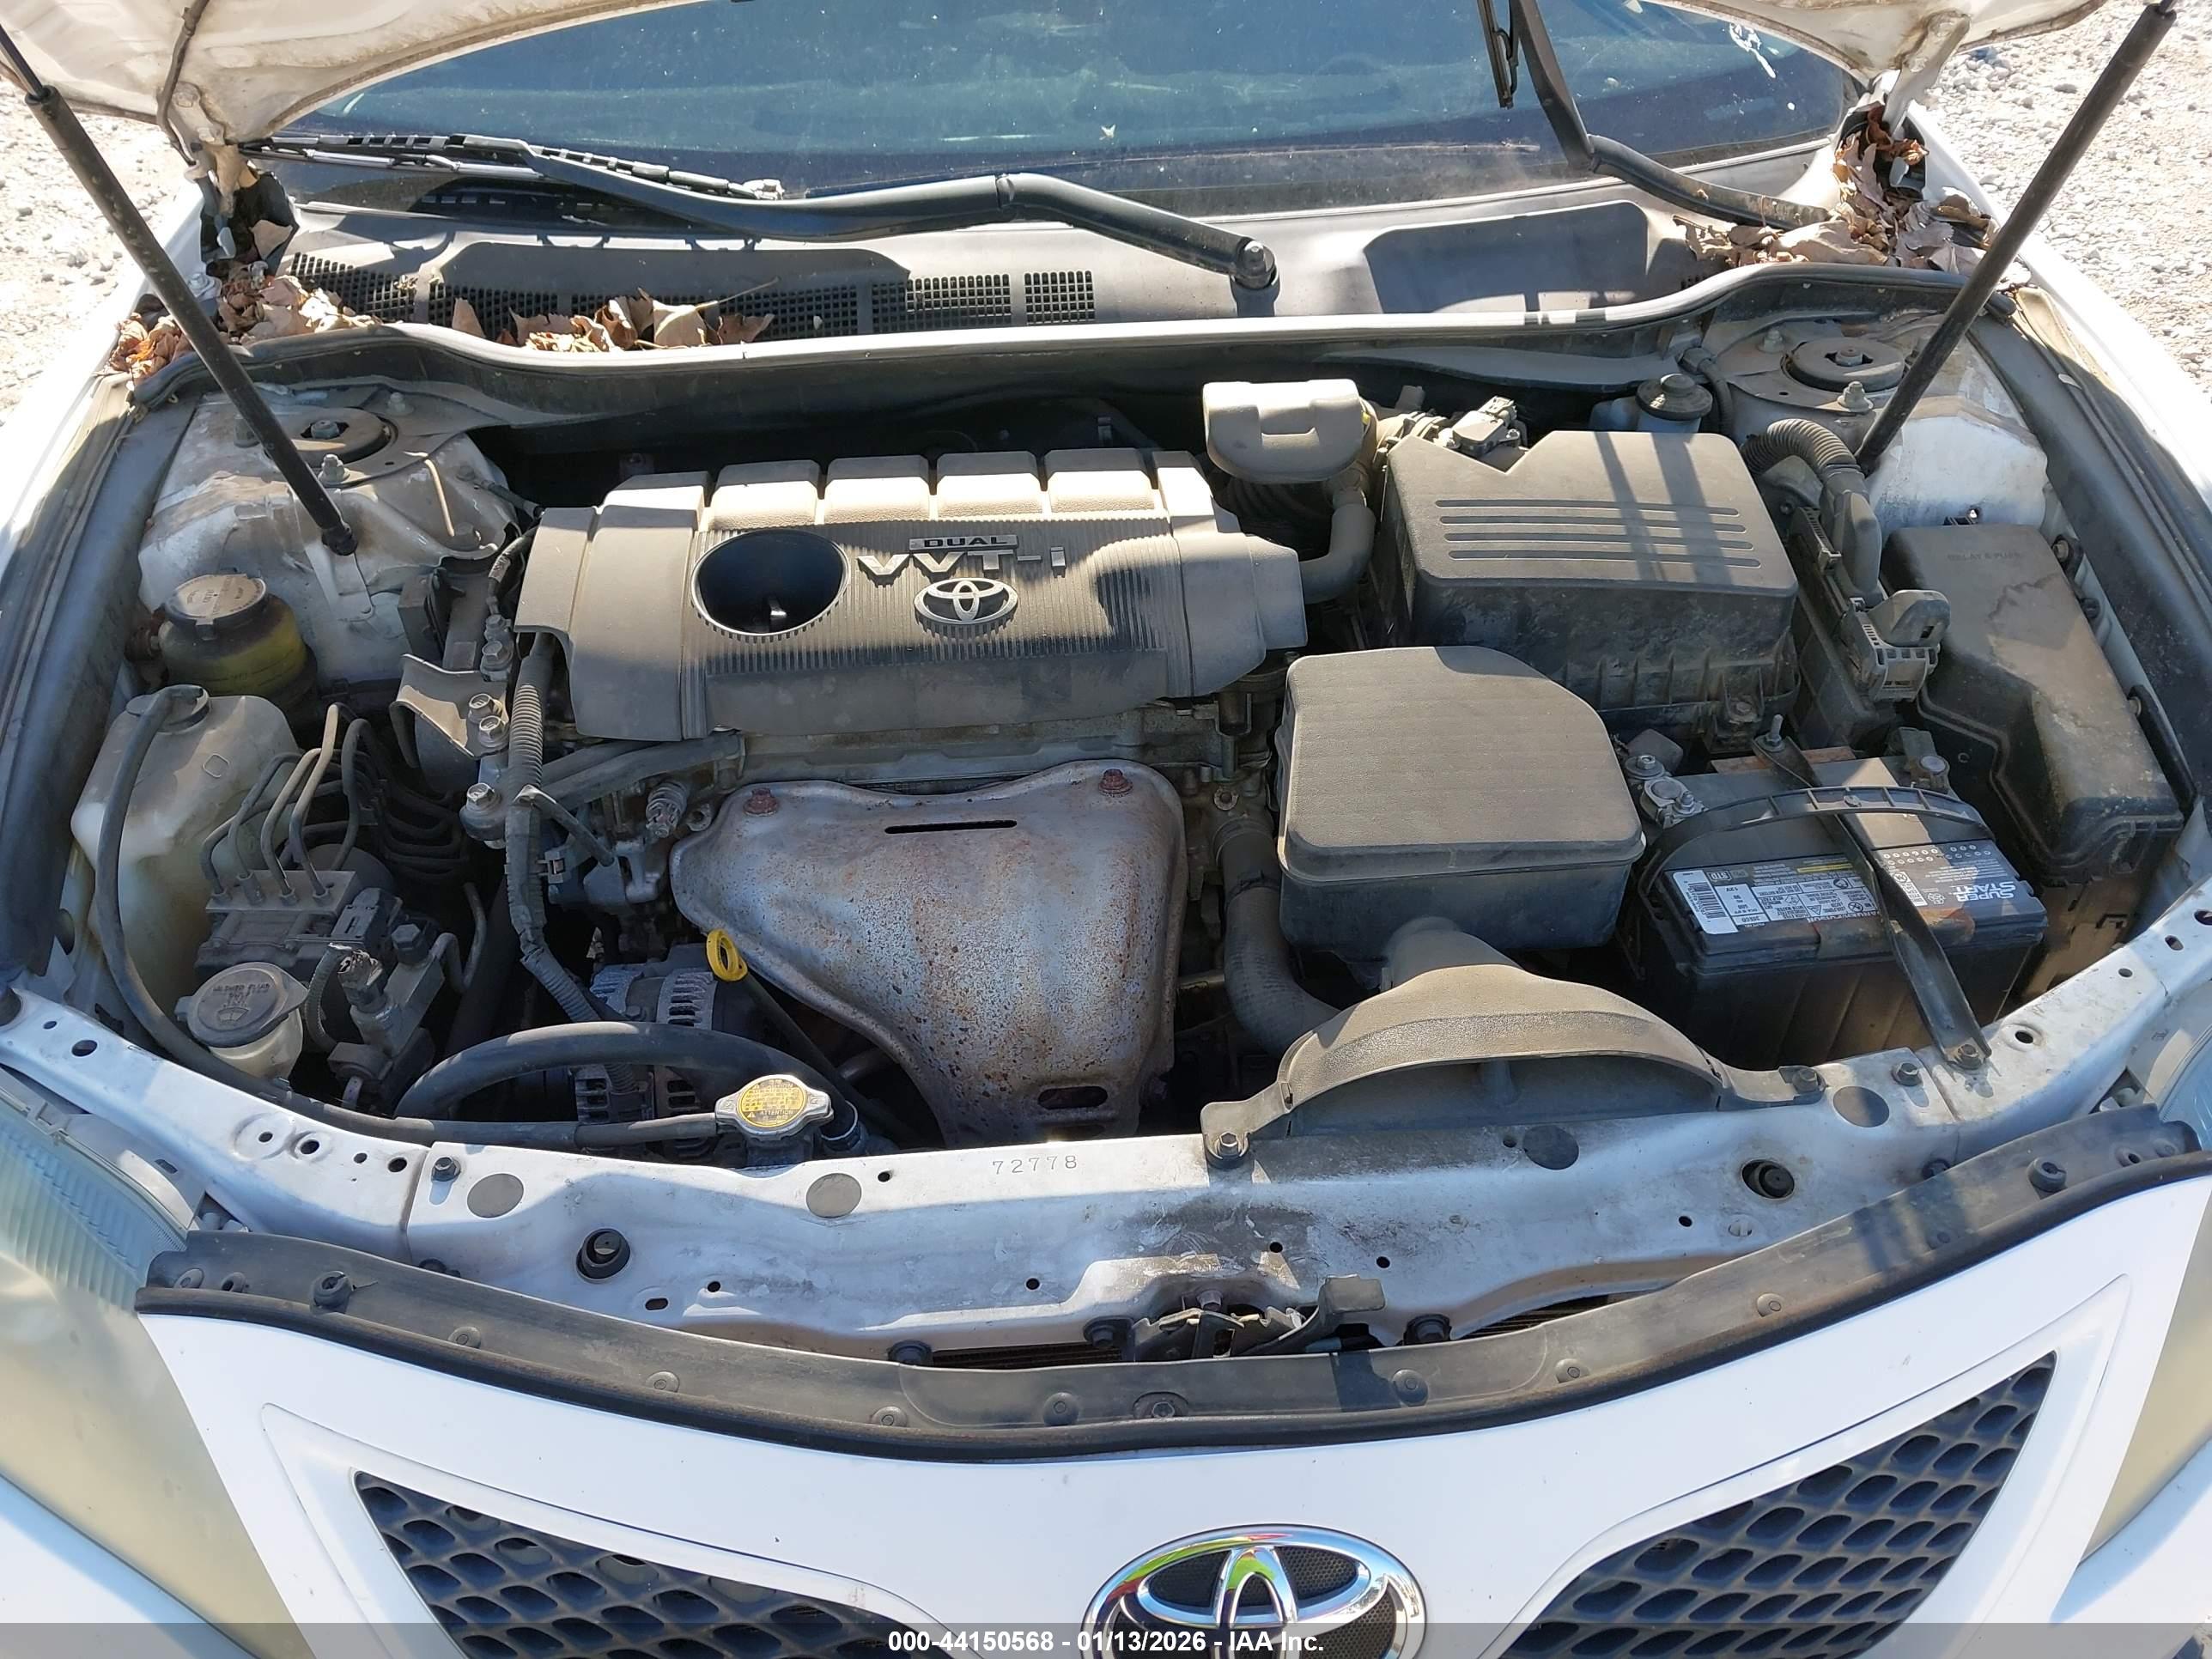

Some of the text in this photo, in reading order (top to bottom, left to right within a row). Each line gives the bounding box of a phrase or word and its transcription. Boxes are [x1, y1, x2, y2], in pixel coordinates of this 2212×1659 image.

[924, 536, 1008, 548] DUAL
[1952, 881, 2016, 895] START
[1956, 890, 2014, 902] SUPER
[992, 1155, 1078, 1175] 72778
